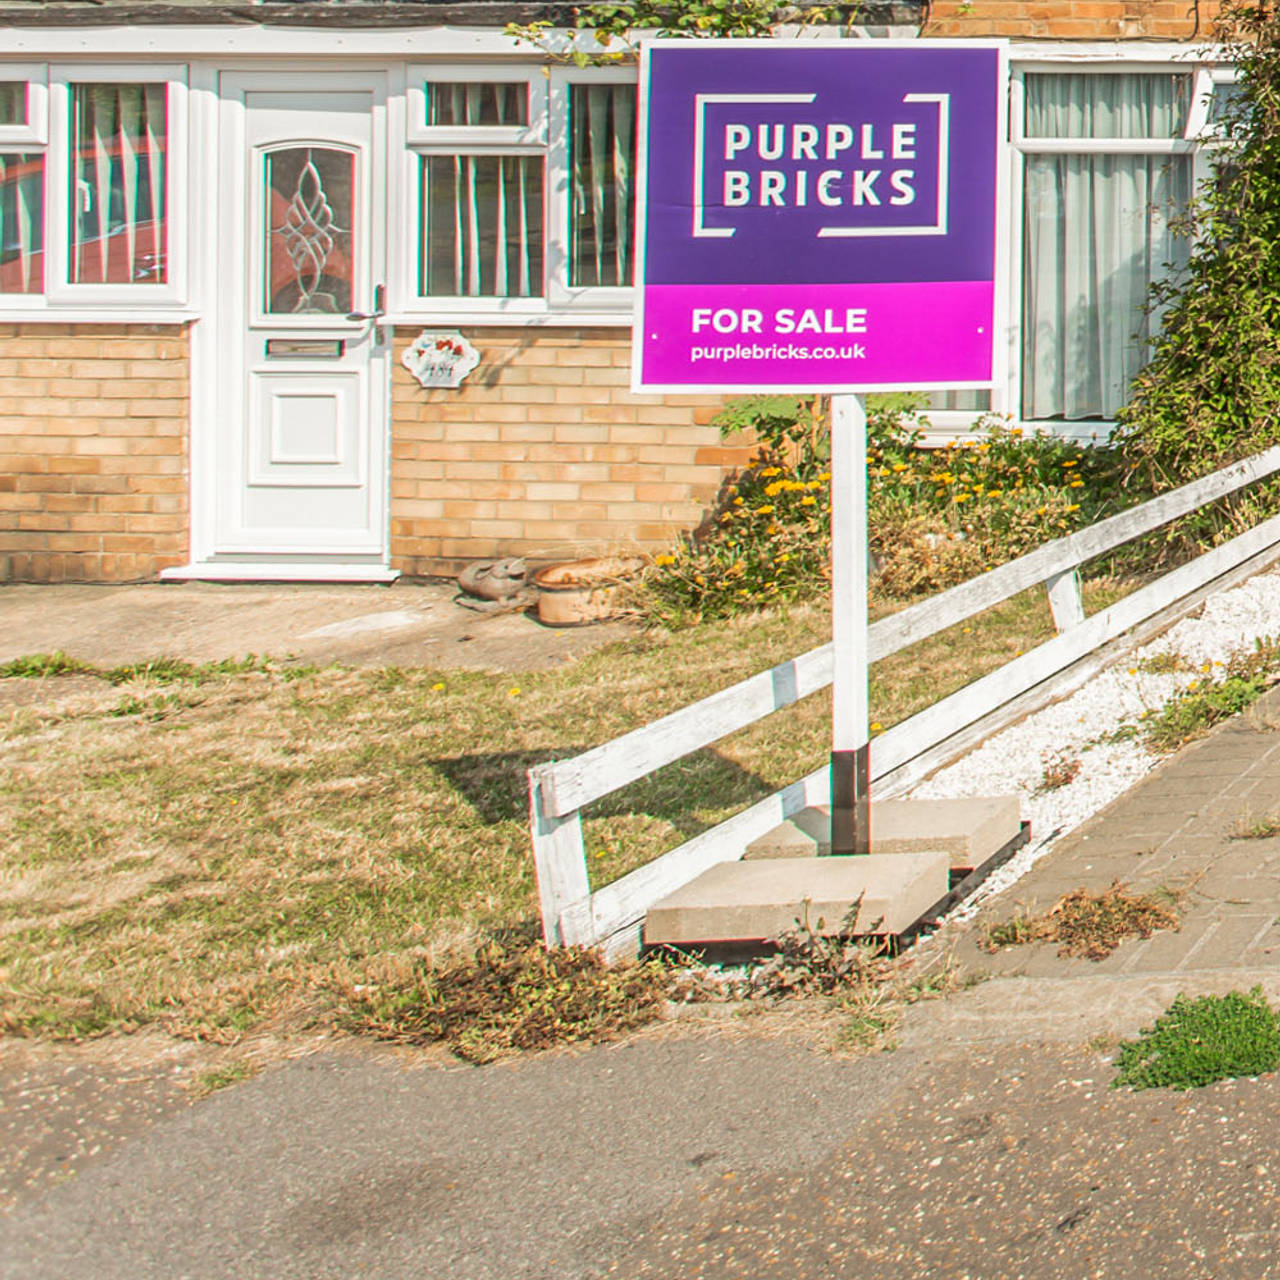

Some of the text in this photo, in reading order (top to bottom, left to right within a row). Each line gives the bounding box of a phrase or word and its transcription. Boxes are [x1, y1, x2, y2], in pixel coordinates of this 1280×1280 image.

[724, 124, 916, 160] PURPLE
[723, 170, 915, 207] BRICKS
[691, 308, 867, 333] FOR SALE
[691, 343, 866, 362] purplebricks.co.uk
